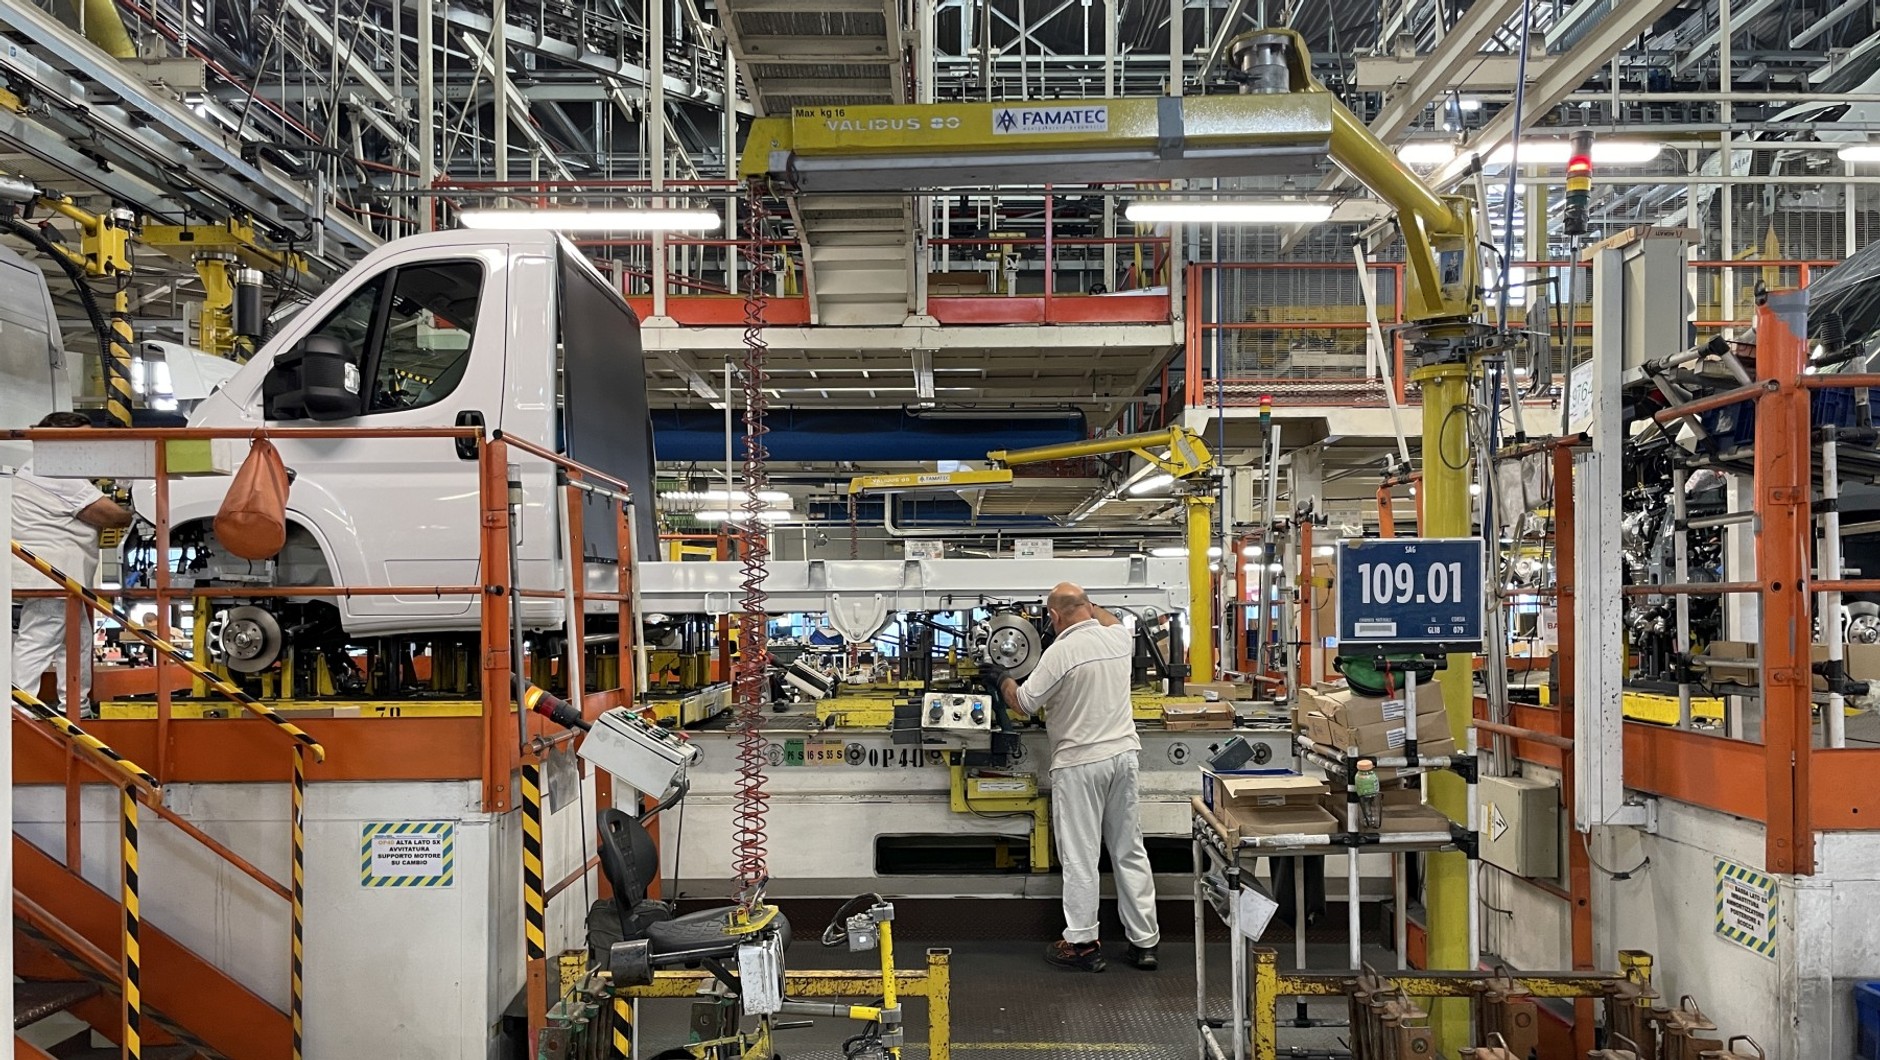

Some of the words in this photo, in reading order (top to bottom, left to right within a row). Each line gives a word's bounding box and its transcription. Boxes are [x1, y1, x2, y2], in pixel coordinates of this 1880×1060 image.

[795, 109, 815, 118] Max
[820, 108, 832, 118] kg
[834, 108, 845, 117] 16
[1022, 110, 1106, 125] FAMATEC
[826, 118, 921, 131] VALIDUS
[930, 116, 961, 129] 80
[1405, 546, 1417, 554] SAG
[1357, 562, 1462, 604] 109.01
[817, 750, 825, 760] S
[836, 749, 843, 760] S
